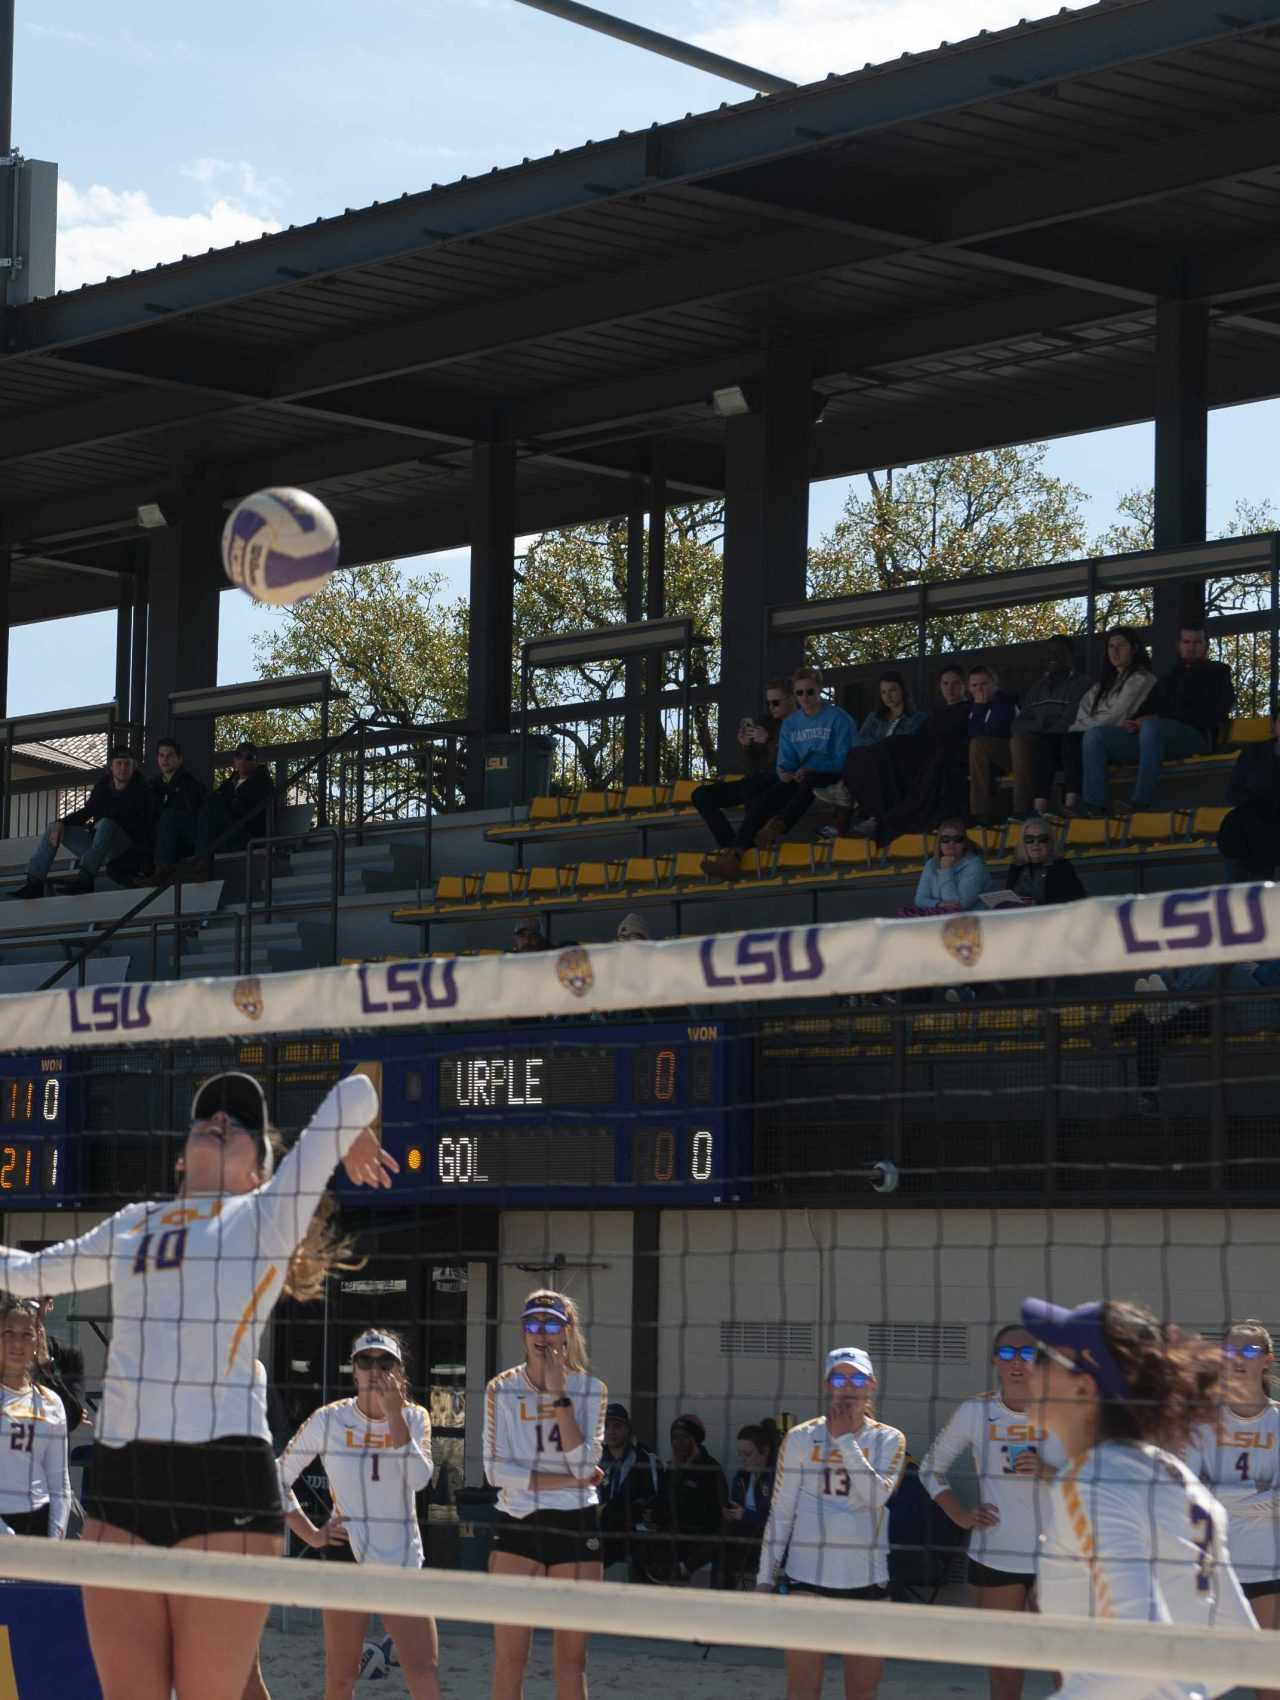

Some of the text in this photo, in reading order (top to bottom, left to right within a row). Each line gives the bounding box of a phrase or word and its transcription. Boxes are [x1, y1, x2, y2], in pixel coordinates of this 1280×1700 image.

[69, 984, 152, 1034] LSU
[358, 960, 459, 1014] LSU
[699, 927, 824, 988] LSU
[1116, 886, 1269, 954] LSU
[687, 1027, 718, 1041] WON
[41, 1059, 62, 1072] WON
[43, 1078, 60, 1120] 0
[50, 1147, 59, 1187] 1
[692, 1131, 713, 1181] 0
[132, 1227, 188, 1275] 10
[520, 1402, 560, 1421] LS
[10, 1423, 35, 1452] 21
[535, 1424, 564, 1452] 14
[988, 1424, 1049, 1443] LSU
[1217, 1431, 1276, 1449] LSU
[370, 1453, 380, 1481] 1
[1235, 1453, 1250, 1481] 4
[822, 1467, 851, 1497] 13
